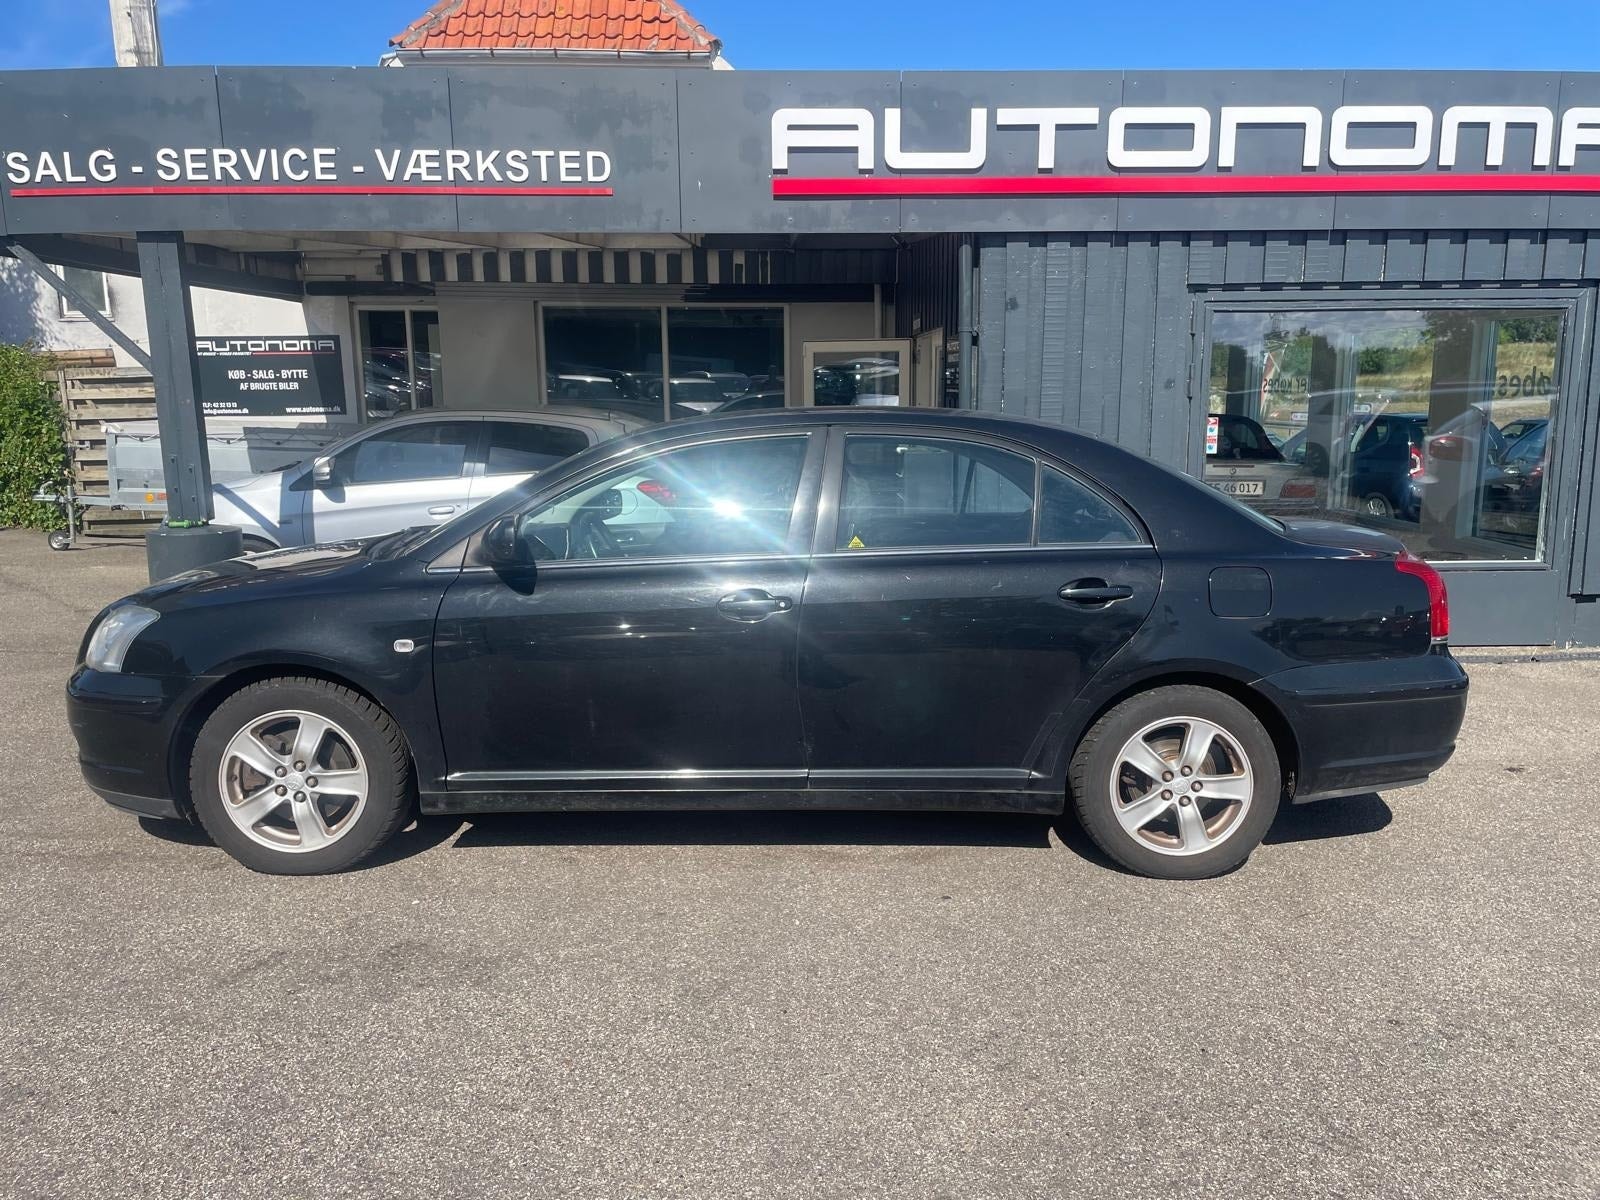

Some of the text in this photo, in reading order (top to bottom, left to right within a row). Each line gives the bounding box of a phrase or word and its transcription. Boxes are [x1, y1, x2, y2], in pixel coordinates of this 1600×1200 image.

[5, 151, 117, 184] SALG
[156, 148, 338, 181] SERVICE
[375, 149, 612, 182] VÆRKSTED
[196, 340, 335, 352] AUTONOMA
[228, 369, 246, 379] KØB
[252, 370, 275, 379] SALG
[281, 369, 308, 379] BYTTE
[279, 382, 299, 390] BILER
[1239, 483, 1258, 493] 017
